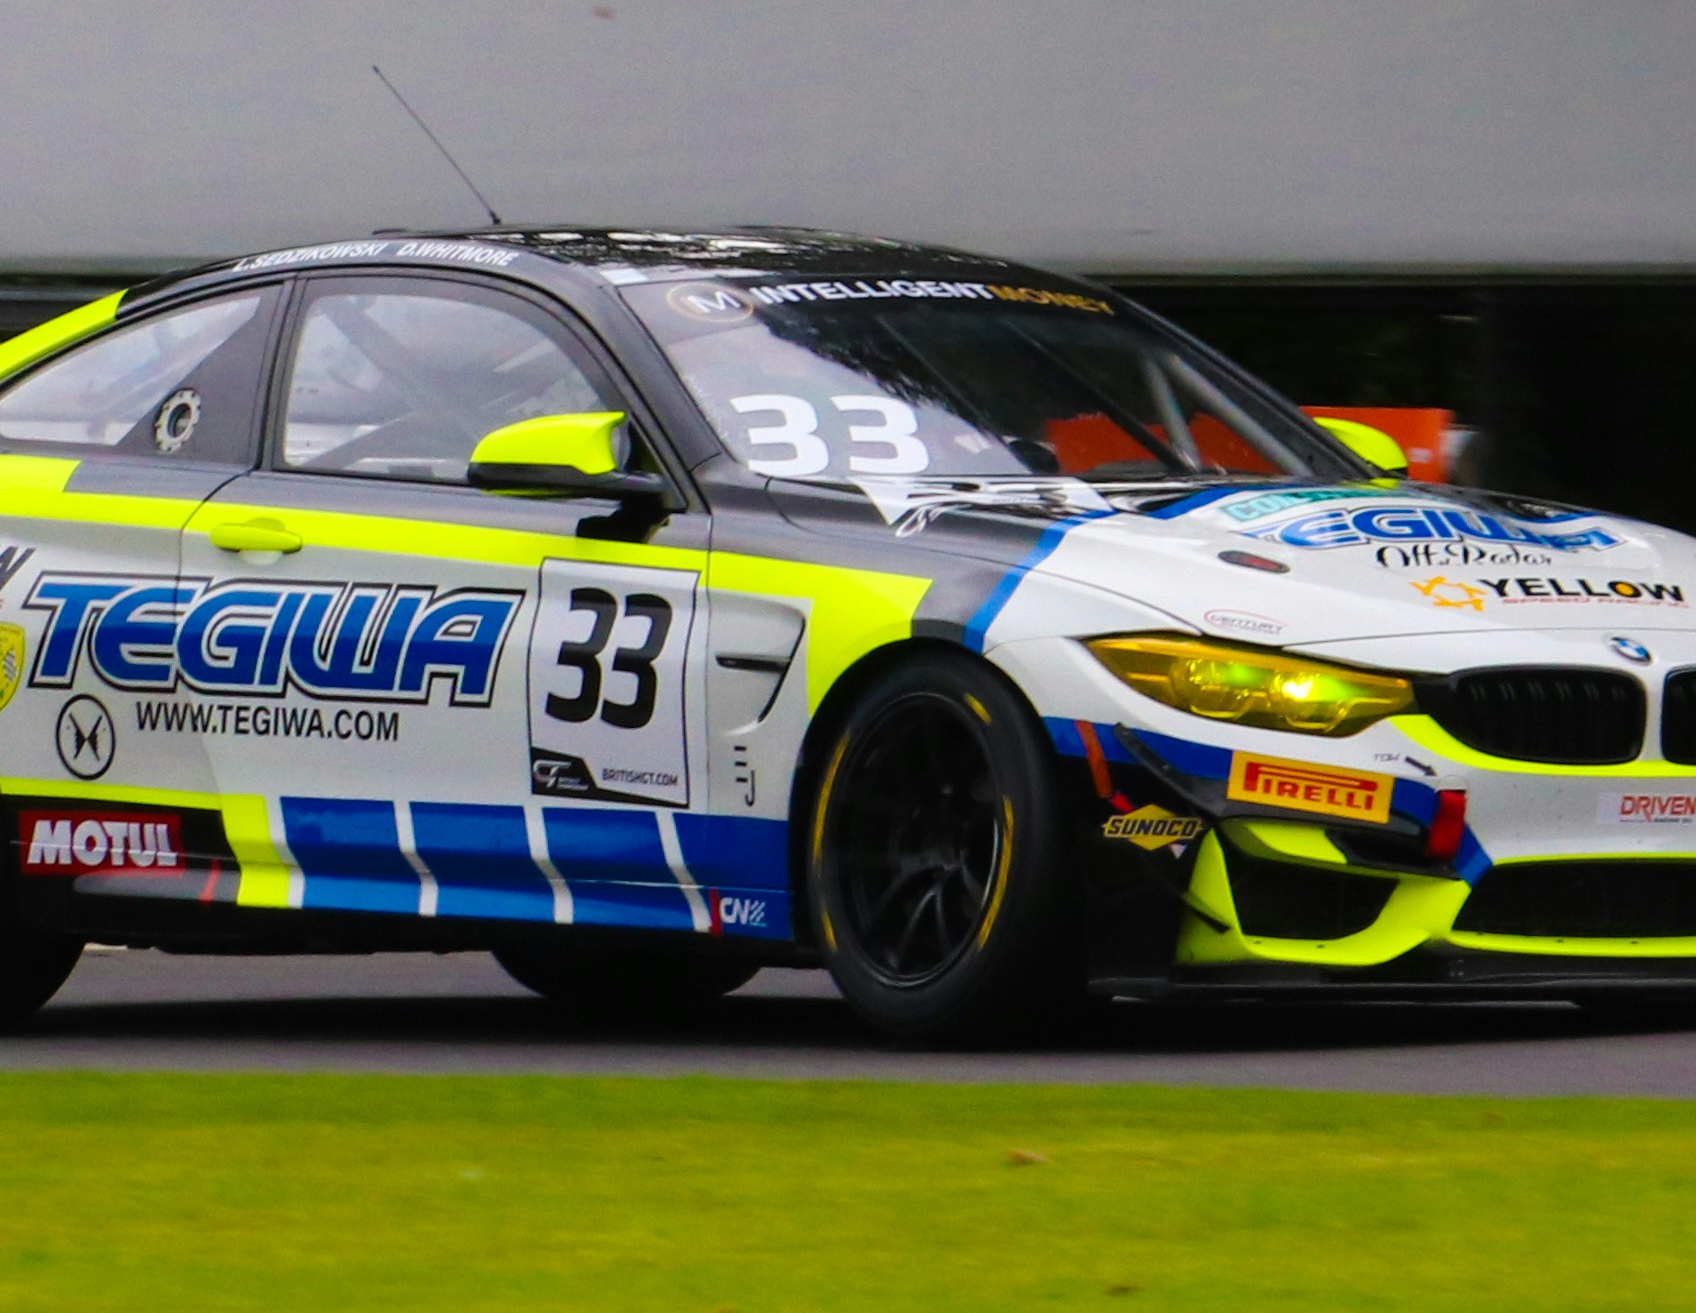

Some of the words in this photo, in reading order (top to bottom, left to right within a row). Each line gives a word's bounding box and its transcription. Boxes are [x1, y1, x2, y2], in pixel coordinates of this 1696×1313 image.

[395, 242, 520, 267] D.WHITMORE
[730, 394, 929, 477] 33
[1477, 577, 1685, 603] YELLOW
[23, 571, 526, 707] TEGIWA
[545, 588, 673, 730] 33
[136, 701, 400, 742] WWW.TEGIWA.COM
[1243, 761, 1378, 811] PIRELLI
[27, 819, 178, 867] MOTUL
[1106, 817, 1199, 837] SUNOCO
